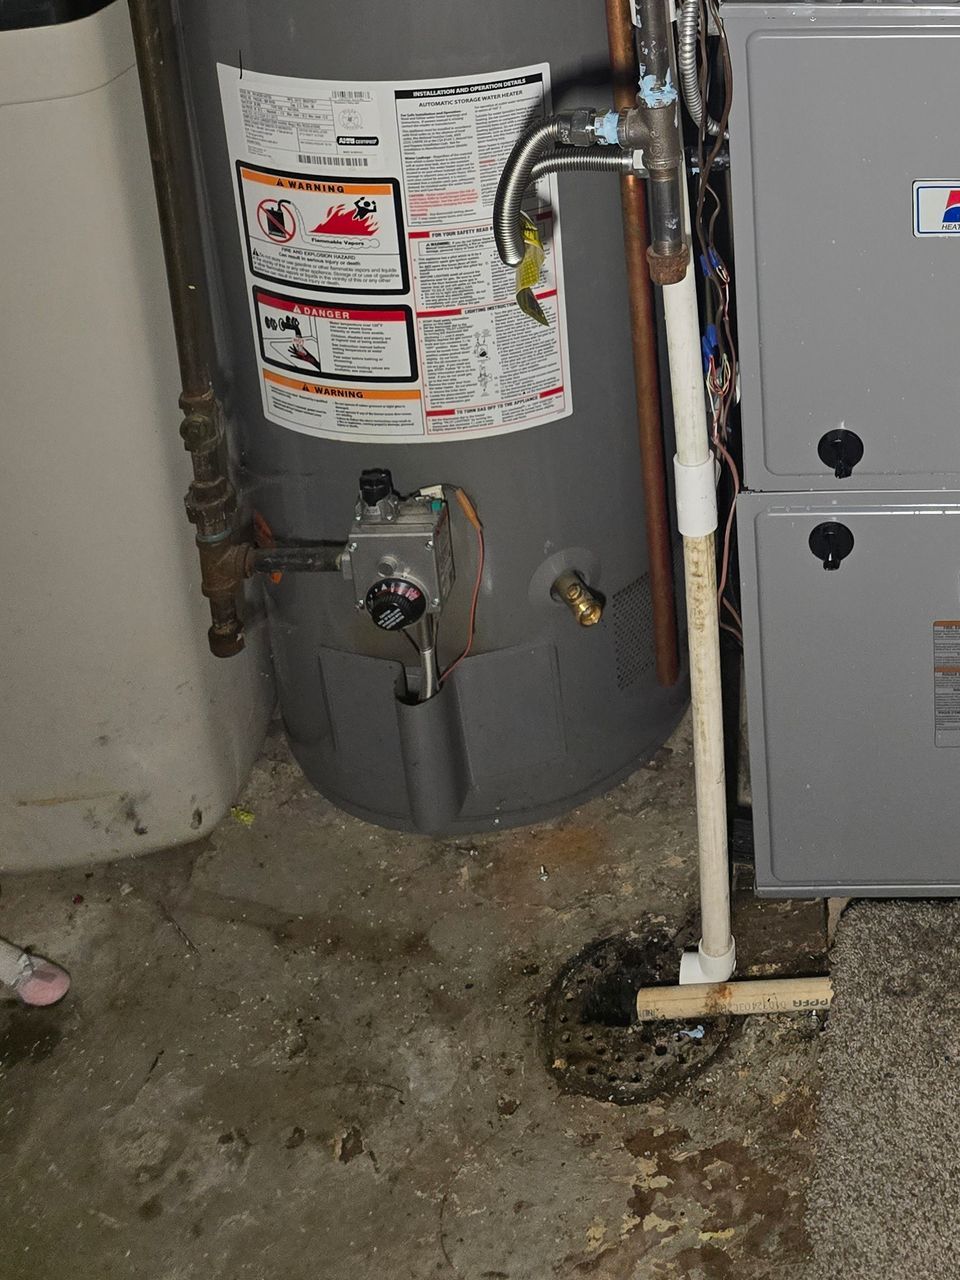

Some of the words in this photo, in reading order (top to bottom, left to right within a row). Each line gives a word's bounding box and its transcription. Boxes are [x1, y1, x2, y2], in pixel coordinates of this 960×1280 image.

[412, 88, 455, 97] INSTALLATION
[470, 82, 503, 92] OPERATION
[503, 78, 526, 87] DETAILS
[418, 99, 453, 108] AUTOMATIC
[454, 96, 481, 105] STORAGE
[482, 93, 501, 102] WATER
[501, 90, 523, 99] HEATER
[288, 180, 344, 193] WARNING
[311, 238, 342, 246] Flammable
[344, 240, 365, 248] Vapors
[304, 251, 333, 259] EXPLOSION
[487, 302, 518, 311] INSTRUCTION
[304, 308, 350, 320] DANGER
[314, 386, 364, 398] WARNING
[513, 396, 538, 407] APPLIANCE
[792, 998, 828, 1008] PPFA
